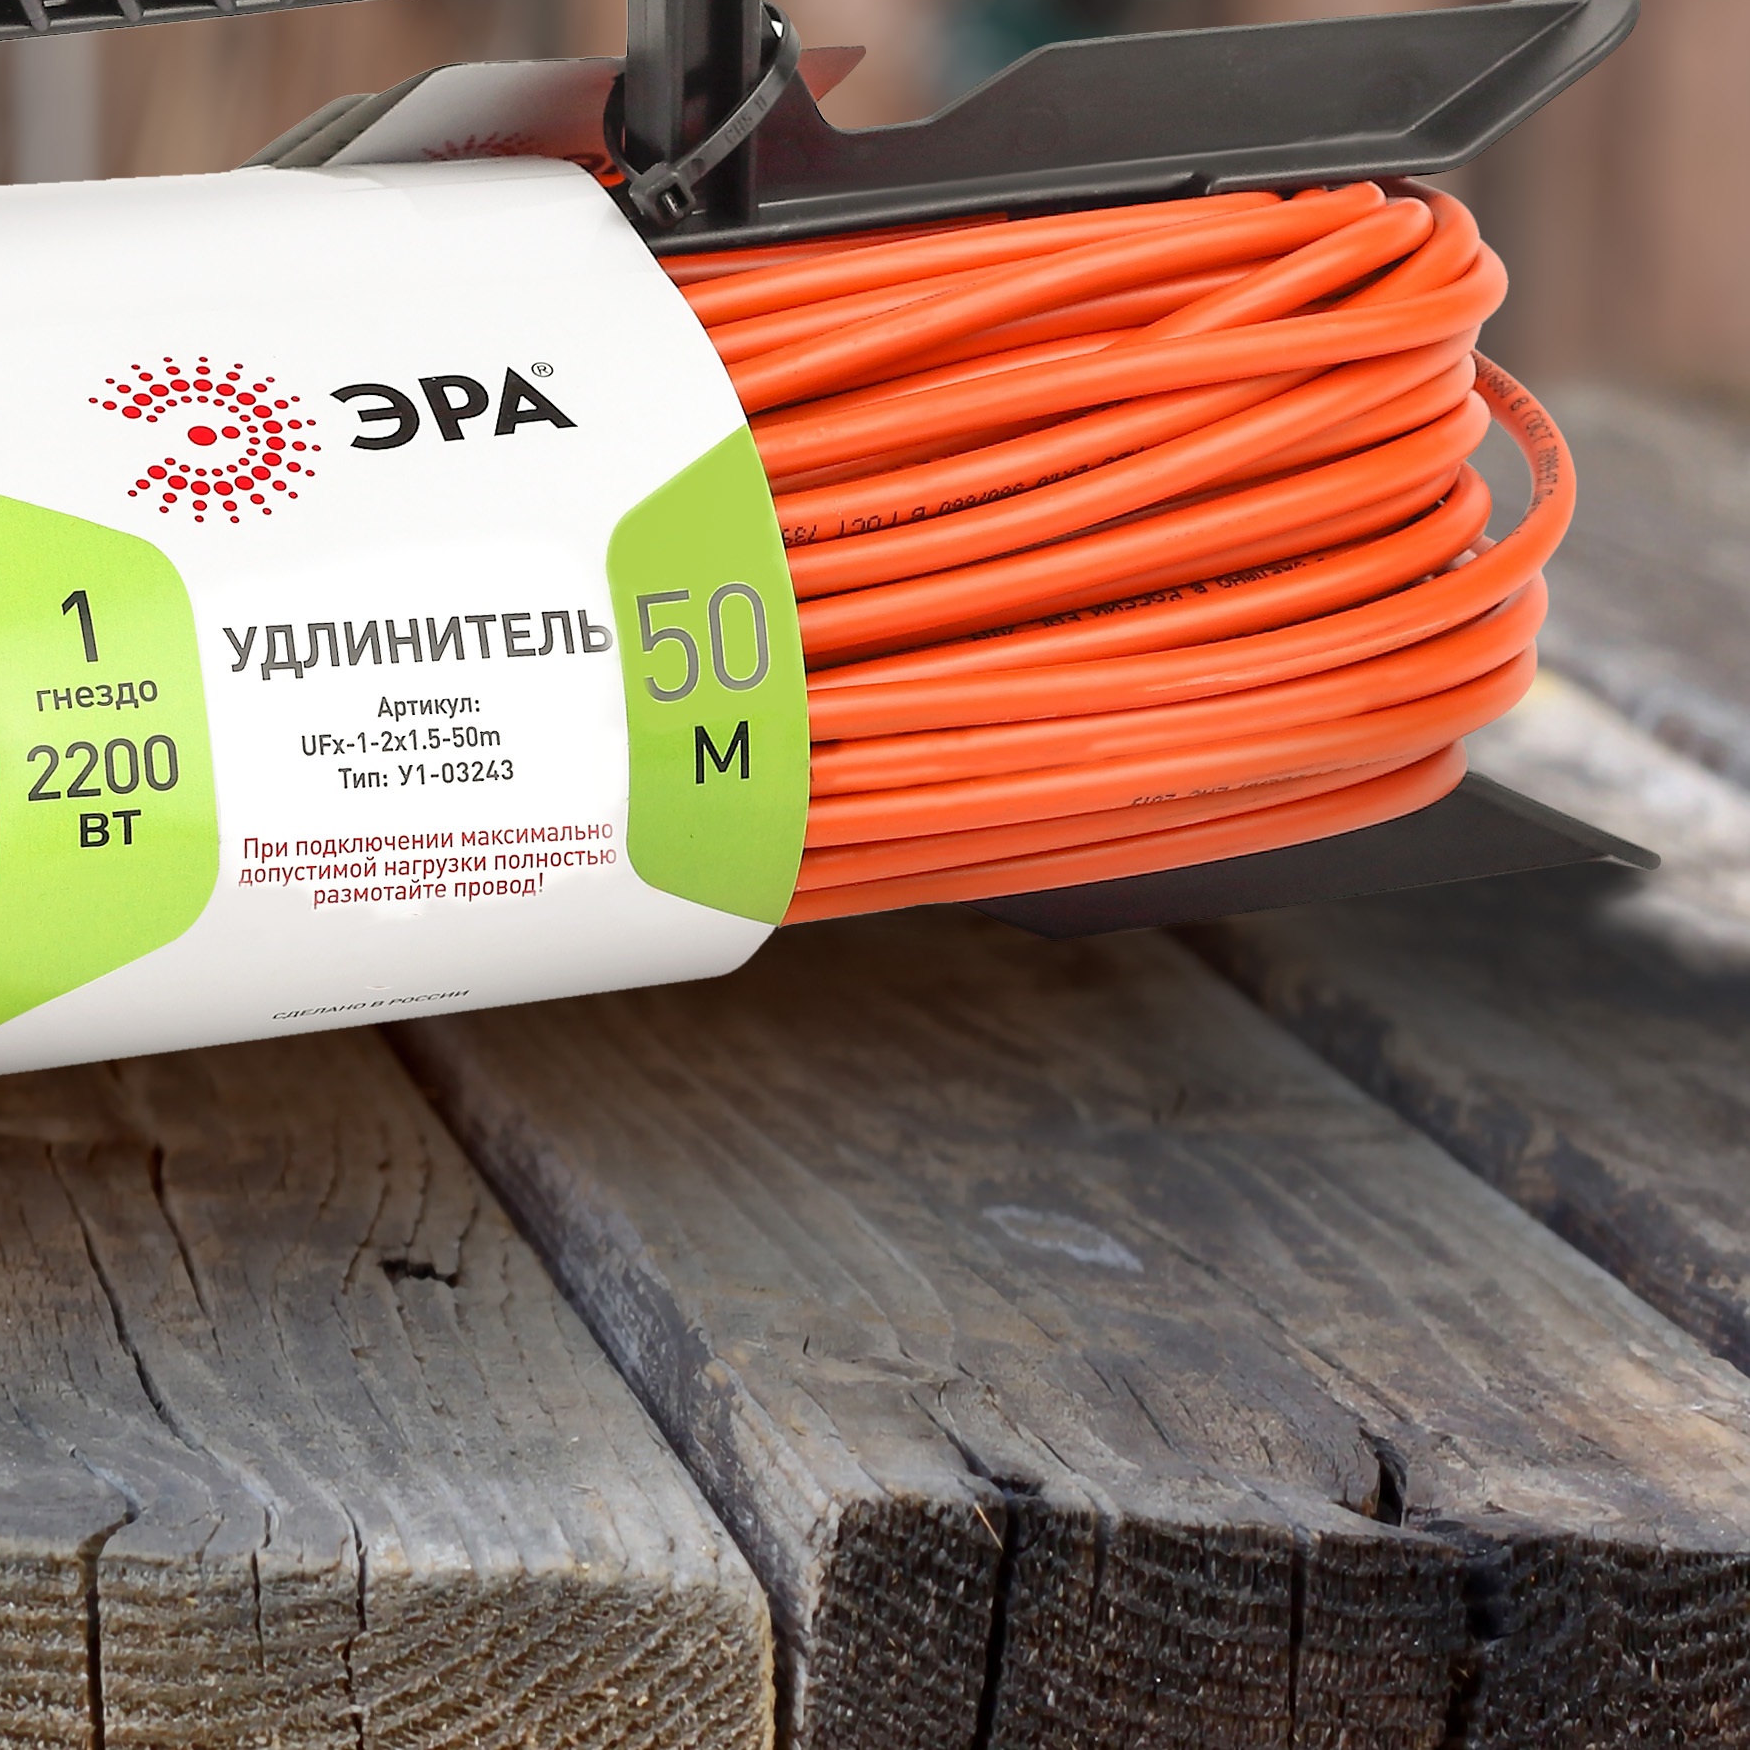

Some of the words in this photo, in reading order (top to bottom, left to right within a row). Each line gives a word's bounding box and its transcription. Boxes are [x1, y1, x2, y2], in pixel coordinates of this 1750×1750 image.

[61, 589, 99, 663] 1
[222, 609, 614, 681] УДЛИНИТЕЛЬ
[636, 582, 771, 702] 50
[35, 679, 159, 712] гнездо
[377, 696, 481, 722] Артикул:
[301, 725, 501, 756] UFx-1-2x1.5-50m
[26, 734, 179, 802] 2200
[338, 767, 388, 789] Тип:
[398, 759, 514, 787] У1-03243
[243, 836, 289, 863] При
[295, 832, 453, 860] подключении
[460, 823, 614, 847] максимально
[239, 854, 378, 888] допустимой
[384, 853, 487, 880] нагрузки
[494, 847, 617, 872] полностью
[313, 879, 447, 910] размотайте
[454, 872, 545, 906] провод!
[272, 1002, 366, 1020] СДЕЛАНО
[370, 999, 384, 1008] В
[388, 989, 470, 1006] РОССИИ
